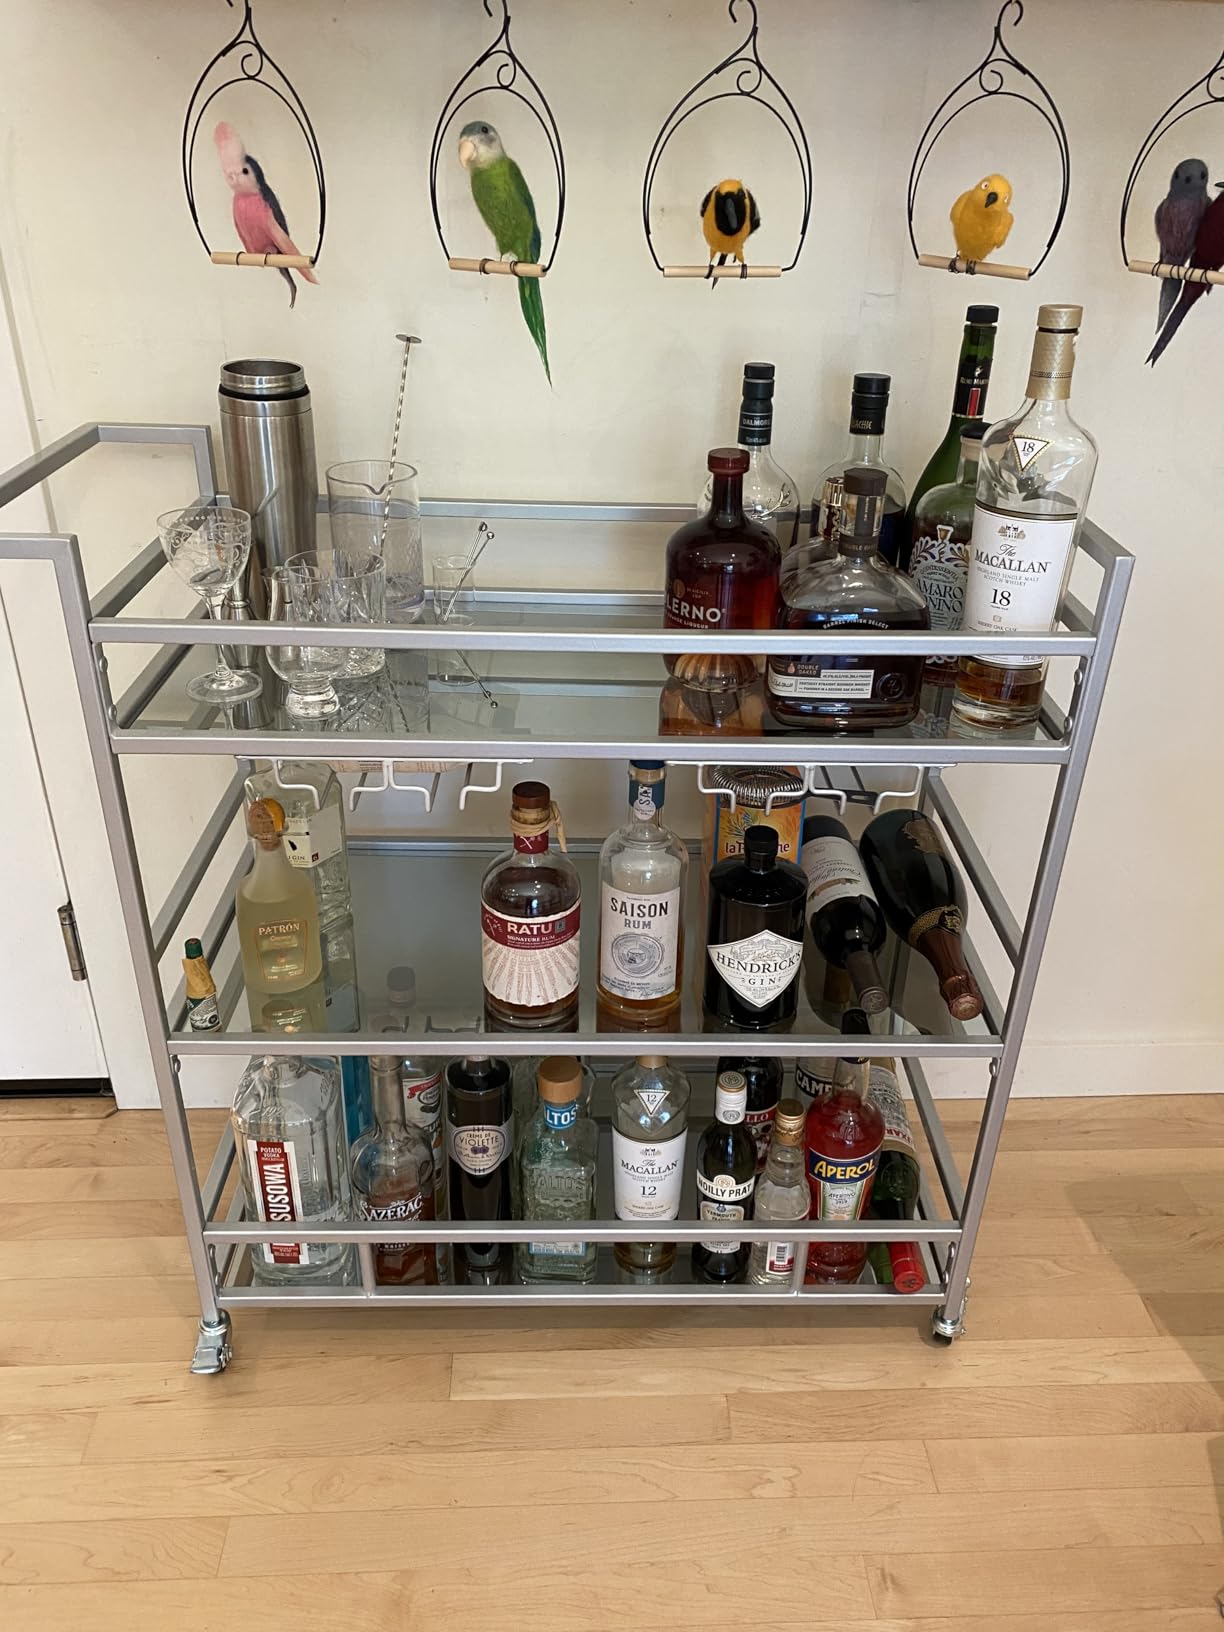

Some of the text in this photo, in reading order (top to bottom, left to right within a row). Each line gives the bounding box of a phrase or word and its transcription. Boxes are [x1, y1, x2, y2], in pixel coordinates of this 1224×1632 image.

[1021, 441, 1035, 453] 18
[997, 543, 1017, 557] The
[975, 549, 1051, 573] MACALLAN
[990, 588, 1012, 606] 18
[797, 663, 819, 671] DOUBLE
[610, 897, 669, 918] SAISON
[258, 922, 300, 935] PATRÓN
[507, 922, 553, 935] RATU
[624, 918, 652, 930] RUM
[507, 934, 541, 942] SIGNATURE
[716, 950, 801, 973] HENDRICK'S
[748, 977, 776, 986] GIN
[647, 1094, 657, 1102] 12
[459, 1135, 499, 1147] VIOLETTE
[260, 1146, 282, 1154] POTATO
[621, 1159, 679, 1175] MACALLAN
[814, 1158, 875, 1179] APEROL
[640, 1185, 657, 1196] 12
[728, 1183, 752, 1198] PRAT
[707, 1208, 737, 1217] VERMOUTH
